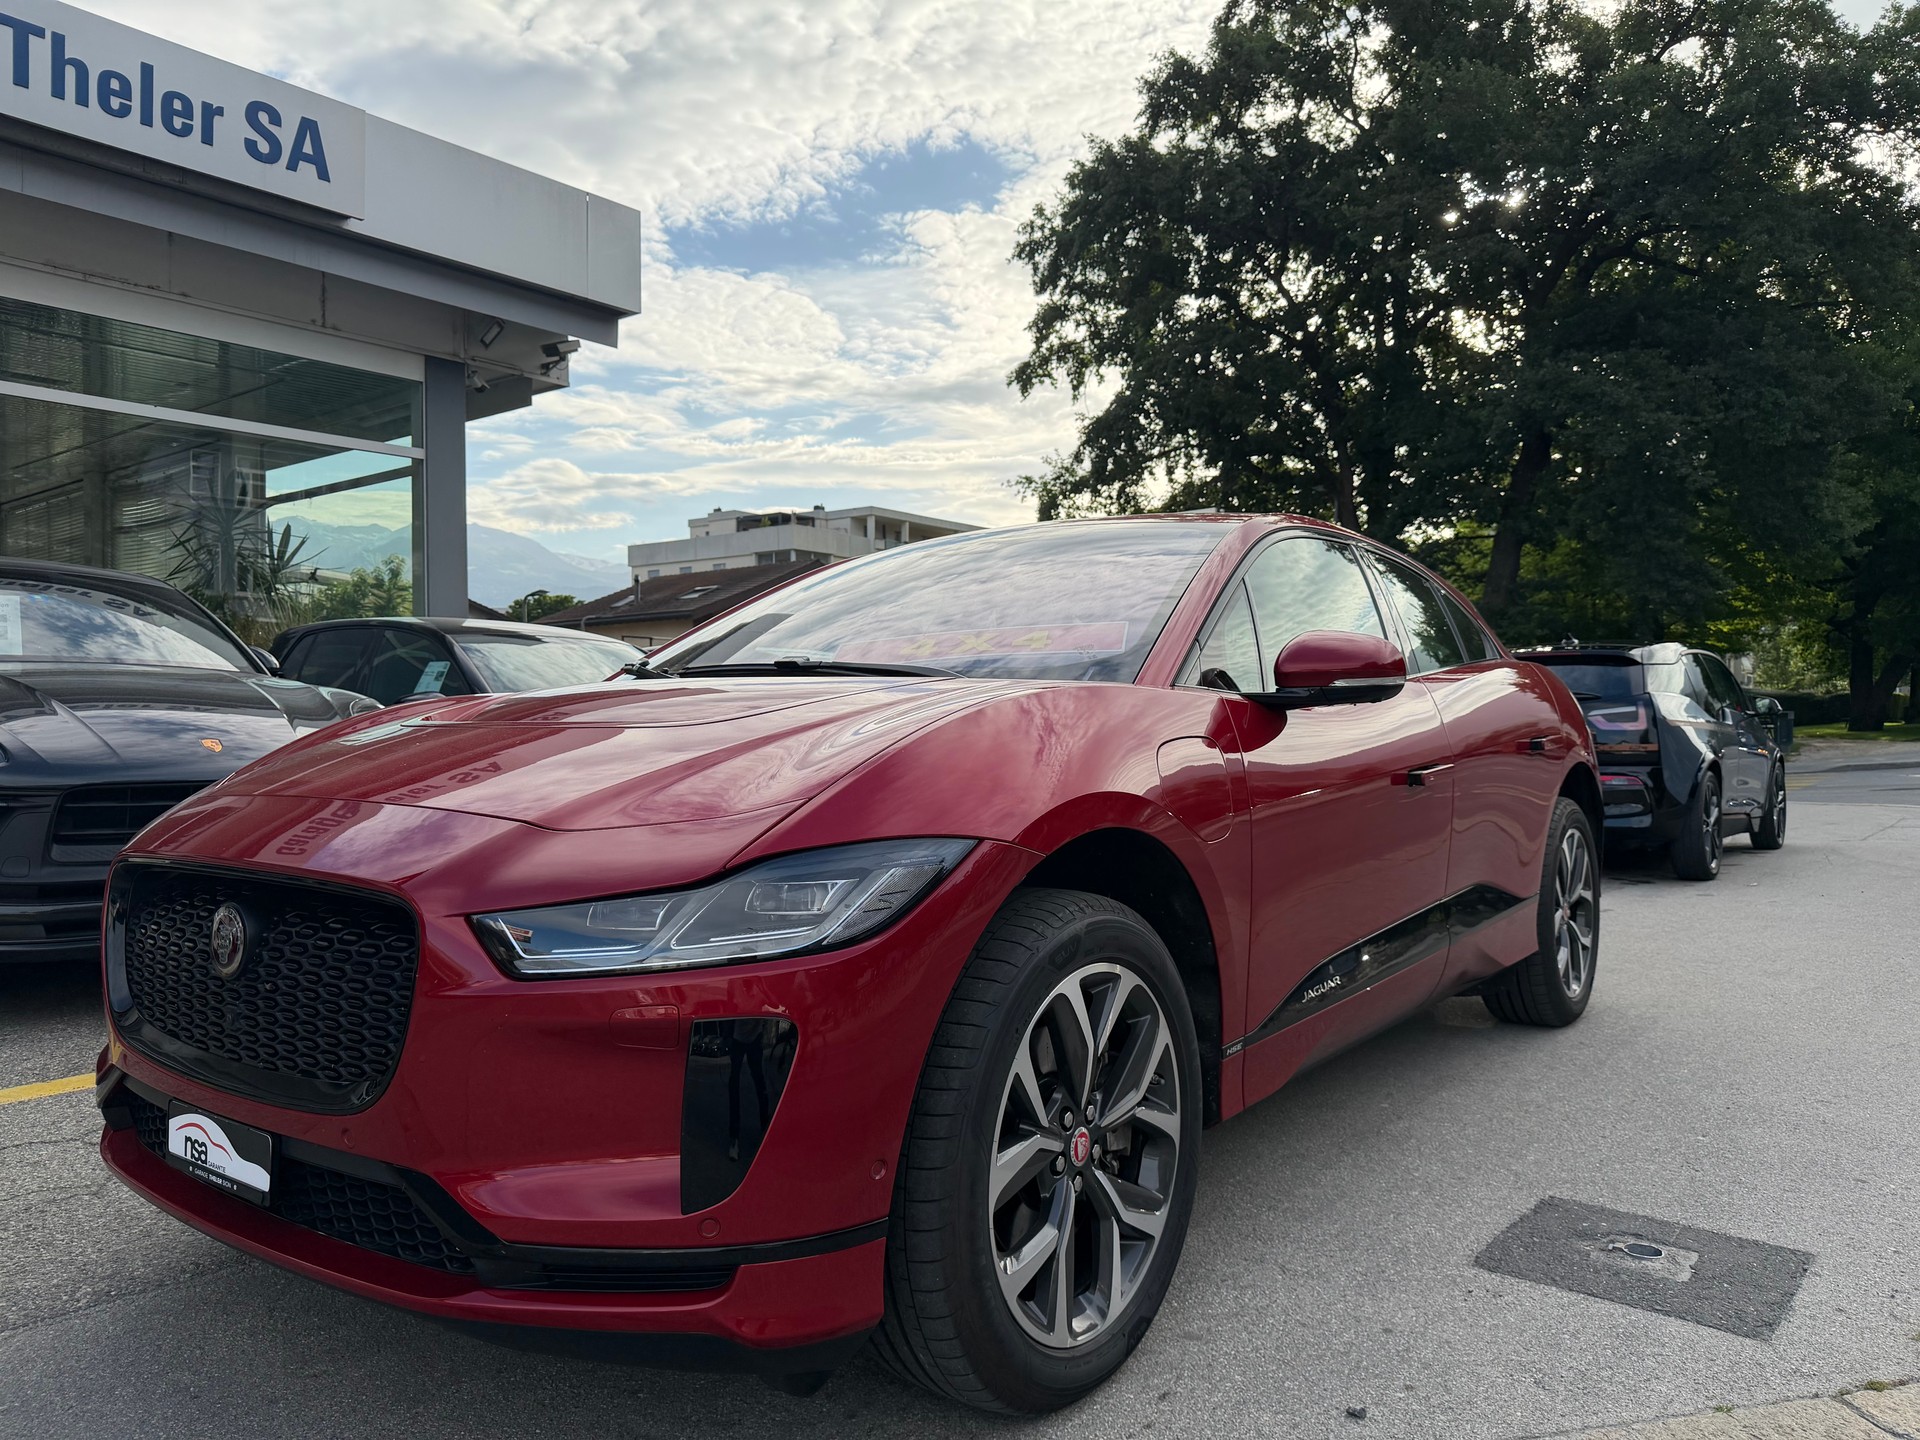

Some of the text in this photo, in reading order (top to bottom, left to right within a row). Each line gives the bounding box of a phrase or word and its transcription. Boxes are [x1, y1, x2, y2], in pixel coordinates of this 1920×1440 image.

[0, 12, 331, 183] Theler SA
[1302, 975, 1341, 1003] JAGUAR
[1226, 1042, 1243, 1056] HSE
[184, 1135, 208, 1165] nsa
